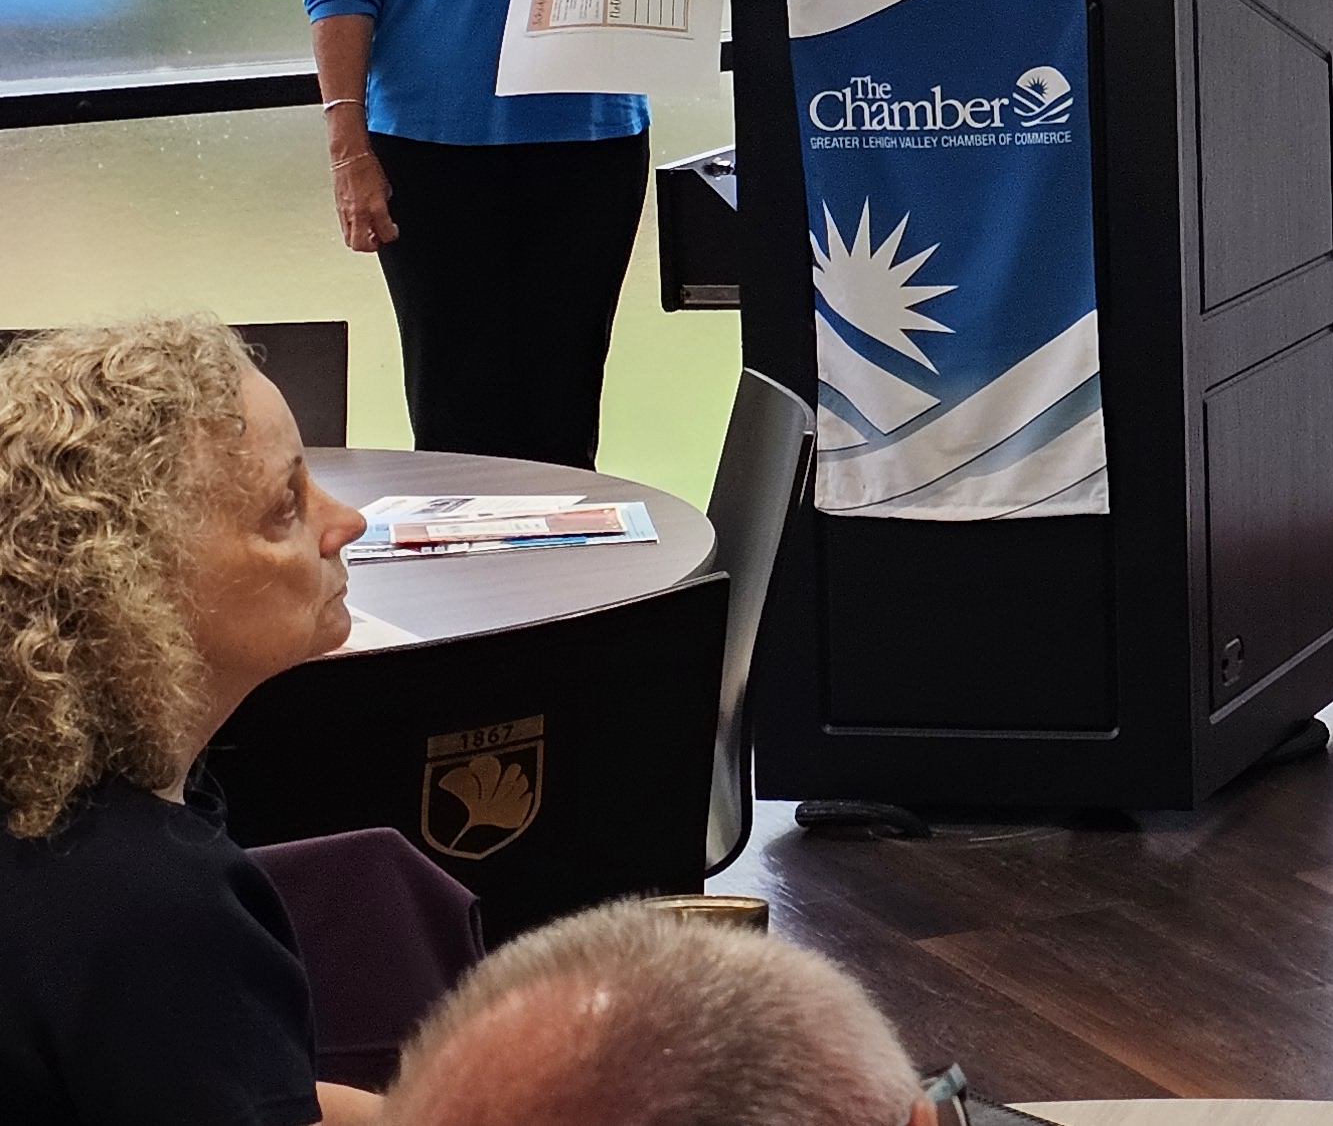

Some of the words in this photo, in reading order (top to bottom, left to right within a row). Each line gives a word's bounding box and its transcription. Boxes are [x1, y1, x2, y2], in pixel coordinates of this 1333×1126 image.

[849, 75, 892, 99] The
[809, 85, 1010, 131] Chamber
[810, 136, 860, 149] GREATER
[862, 136, 897, 149] LEHIGH
[899, 135, 938, 149] VALLEY
[941, 133, 996, 148] CHAMBER
[998, 133, 1013, 146] OF
[1014, 130, 1072, 146] COMMERCE
[460, 723, 514, 750] 1867
